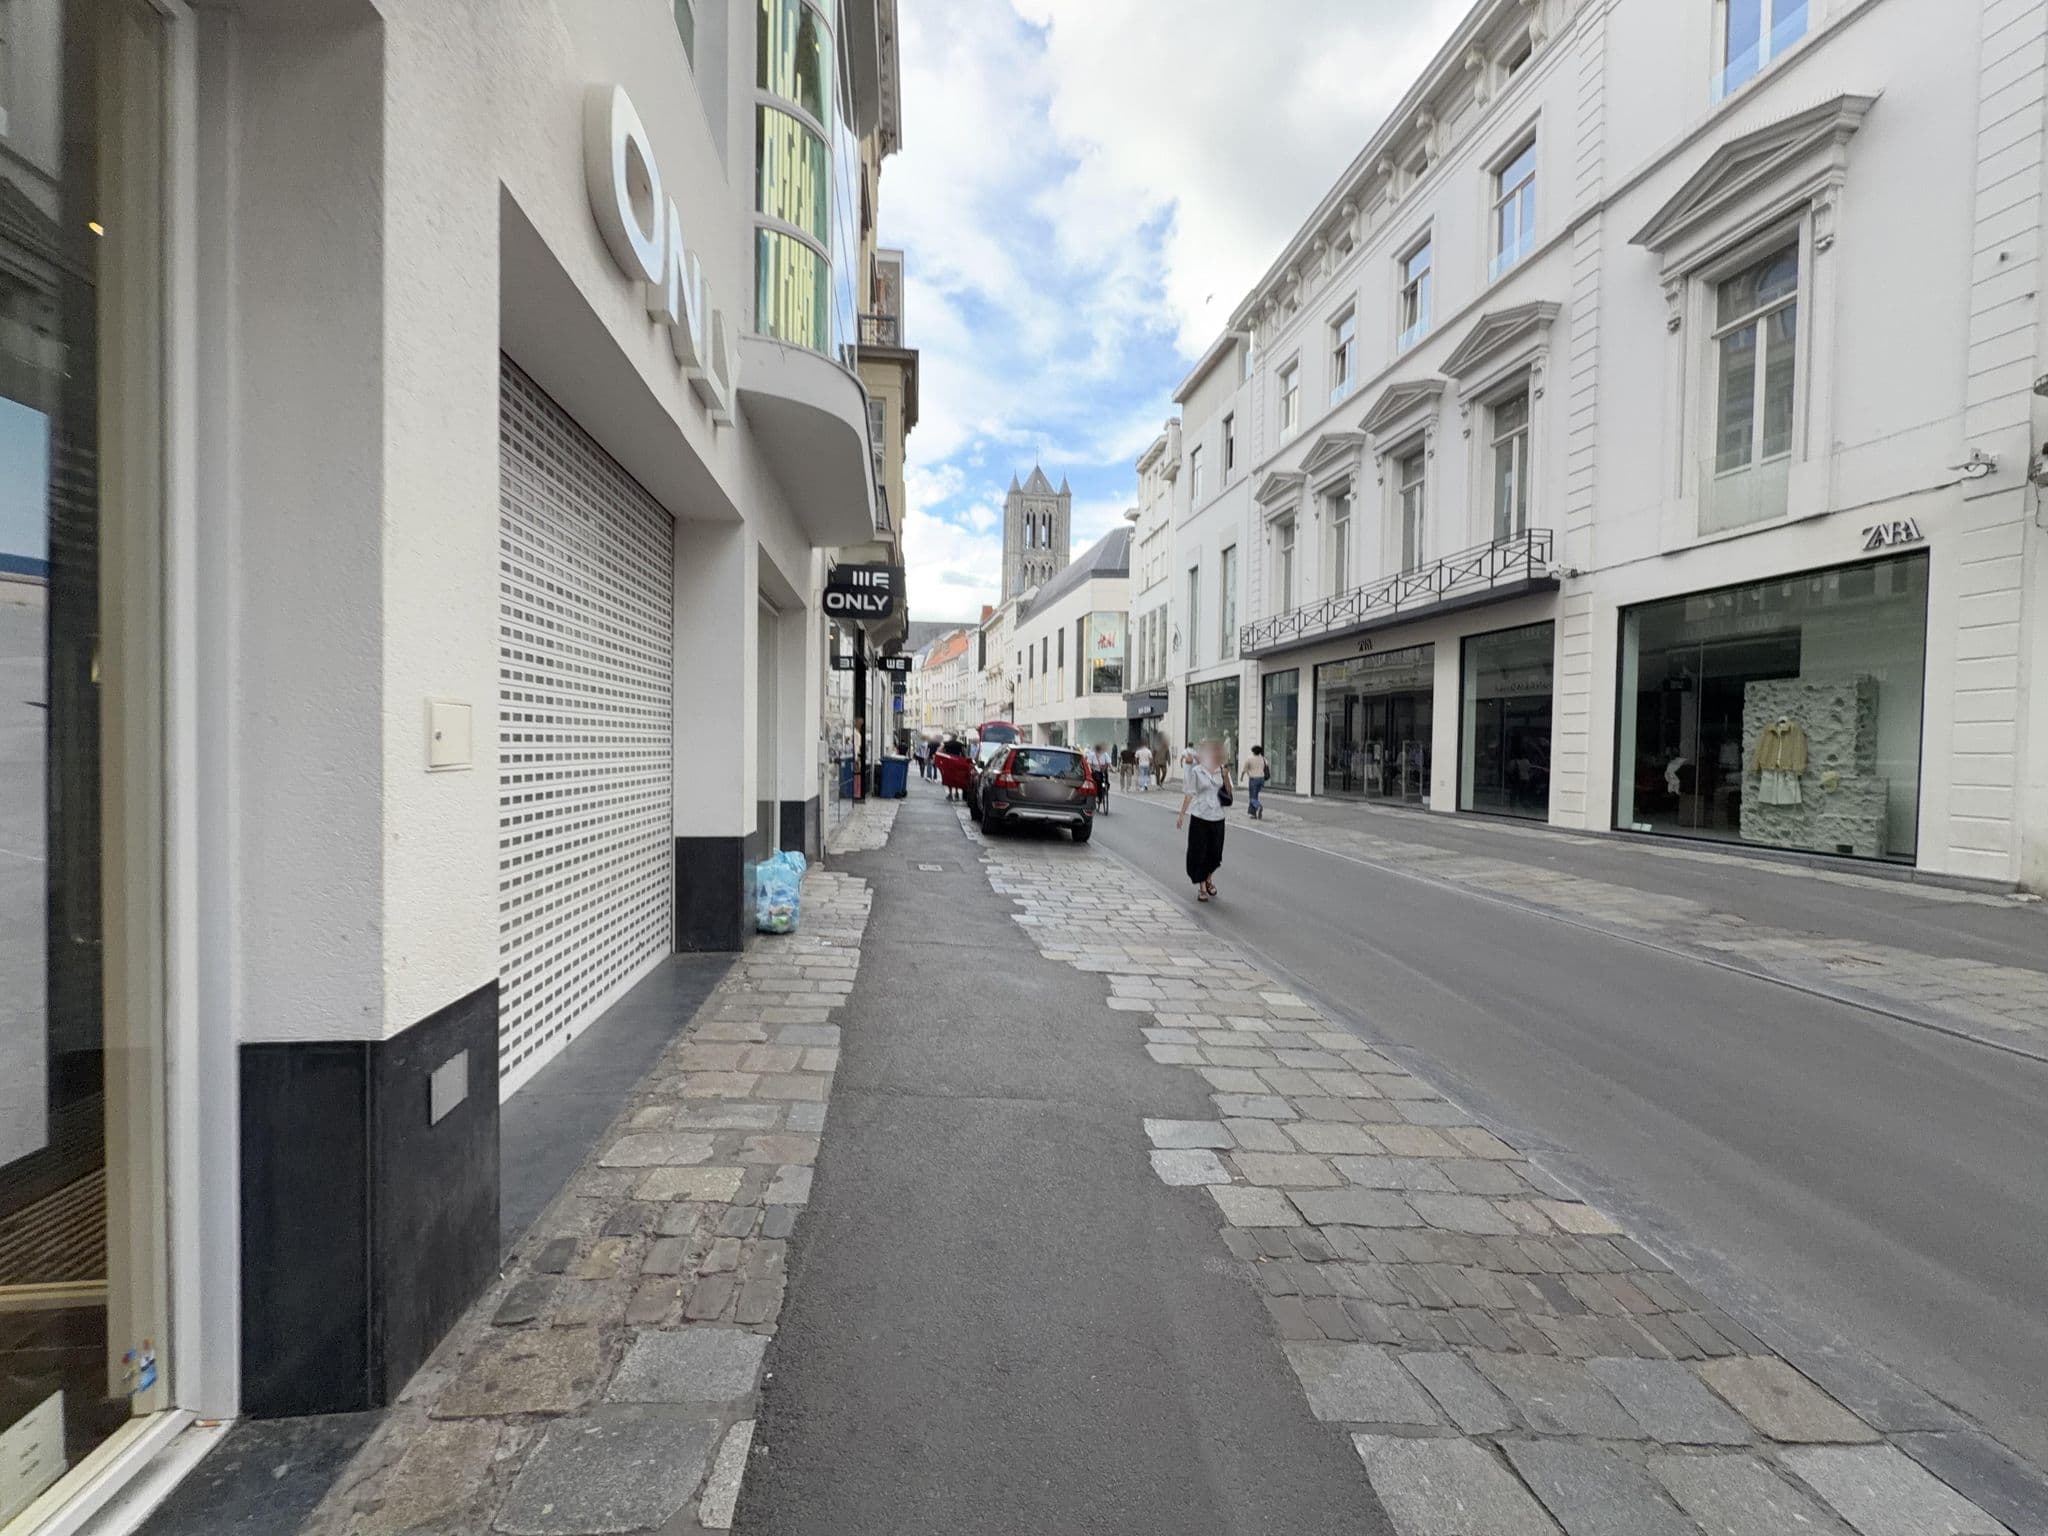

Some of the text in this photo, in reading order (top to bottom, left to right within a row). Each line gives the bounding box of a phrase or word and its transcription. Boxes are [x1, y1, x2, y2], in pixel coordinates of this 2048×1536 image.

[583, 83, 742, 428] ONLY
[1862, 516, 1924, 552] ZARA
[826, 592, 889, 611] ONLY
[886, 658, 905, 669] WE
